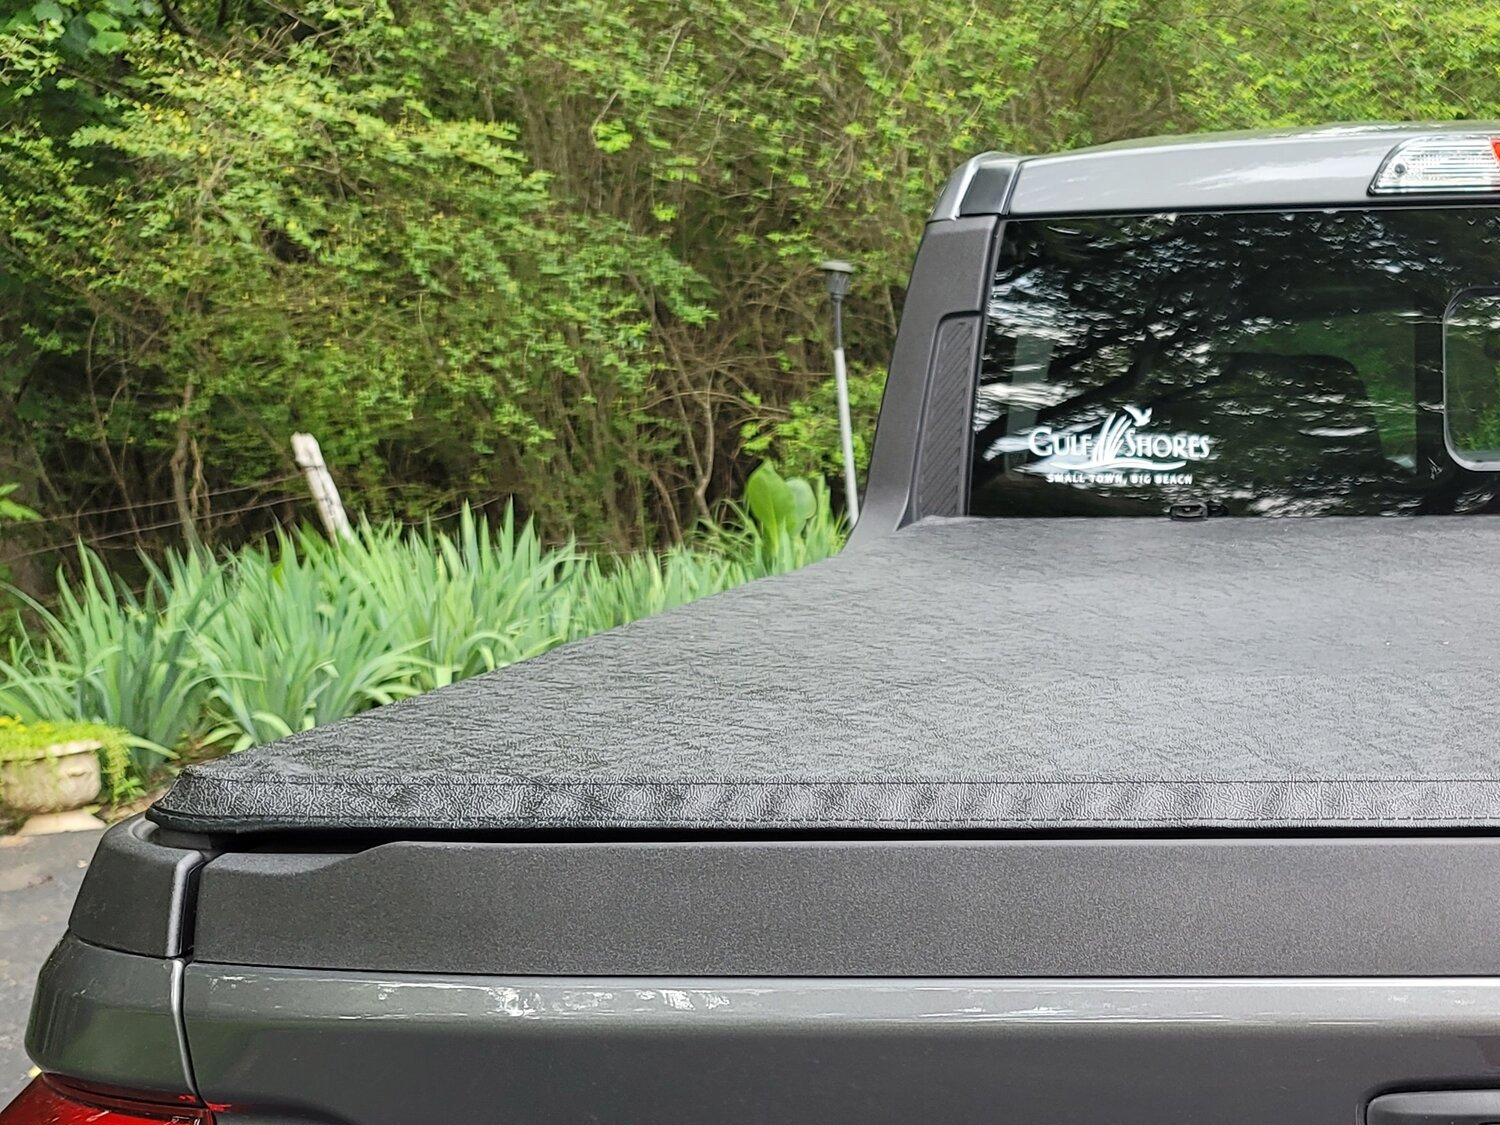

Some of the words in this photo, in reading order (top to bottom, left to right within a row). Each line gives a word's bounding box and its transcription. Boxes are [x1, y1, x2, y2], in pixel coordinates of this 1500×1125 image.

[1028, 426, 1092, 457] GULF
[1124, 427, 1211, 458] SHORES
[1047, 473, 1085, 484] SMALL
[1089, 474, 1127, 486] TOWN,
[1129, 474, 1151, 485] BIG
[1154, 474, 1194, 485] BEACH
